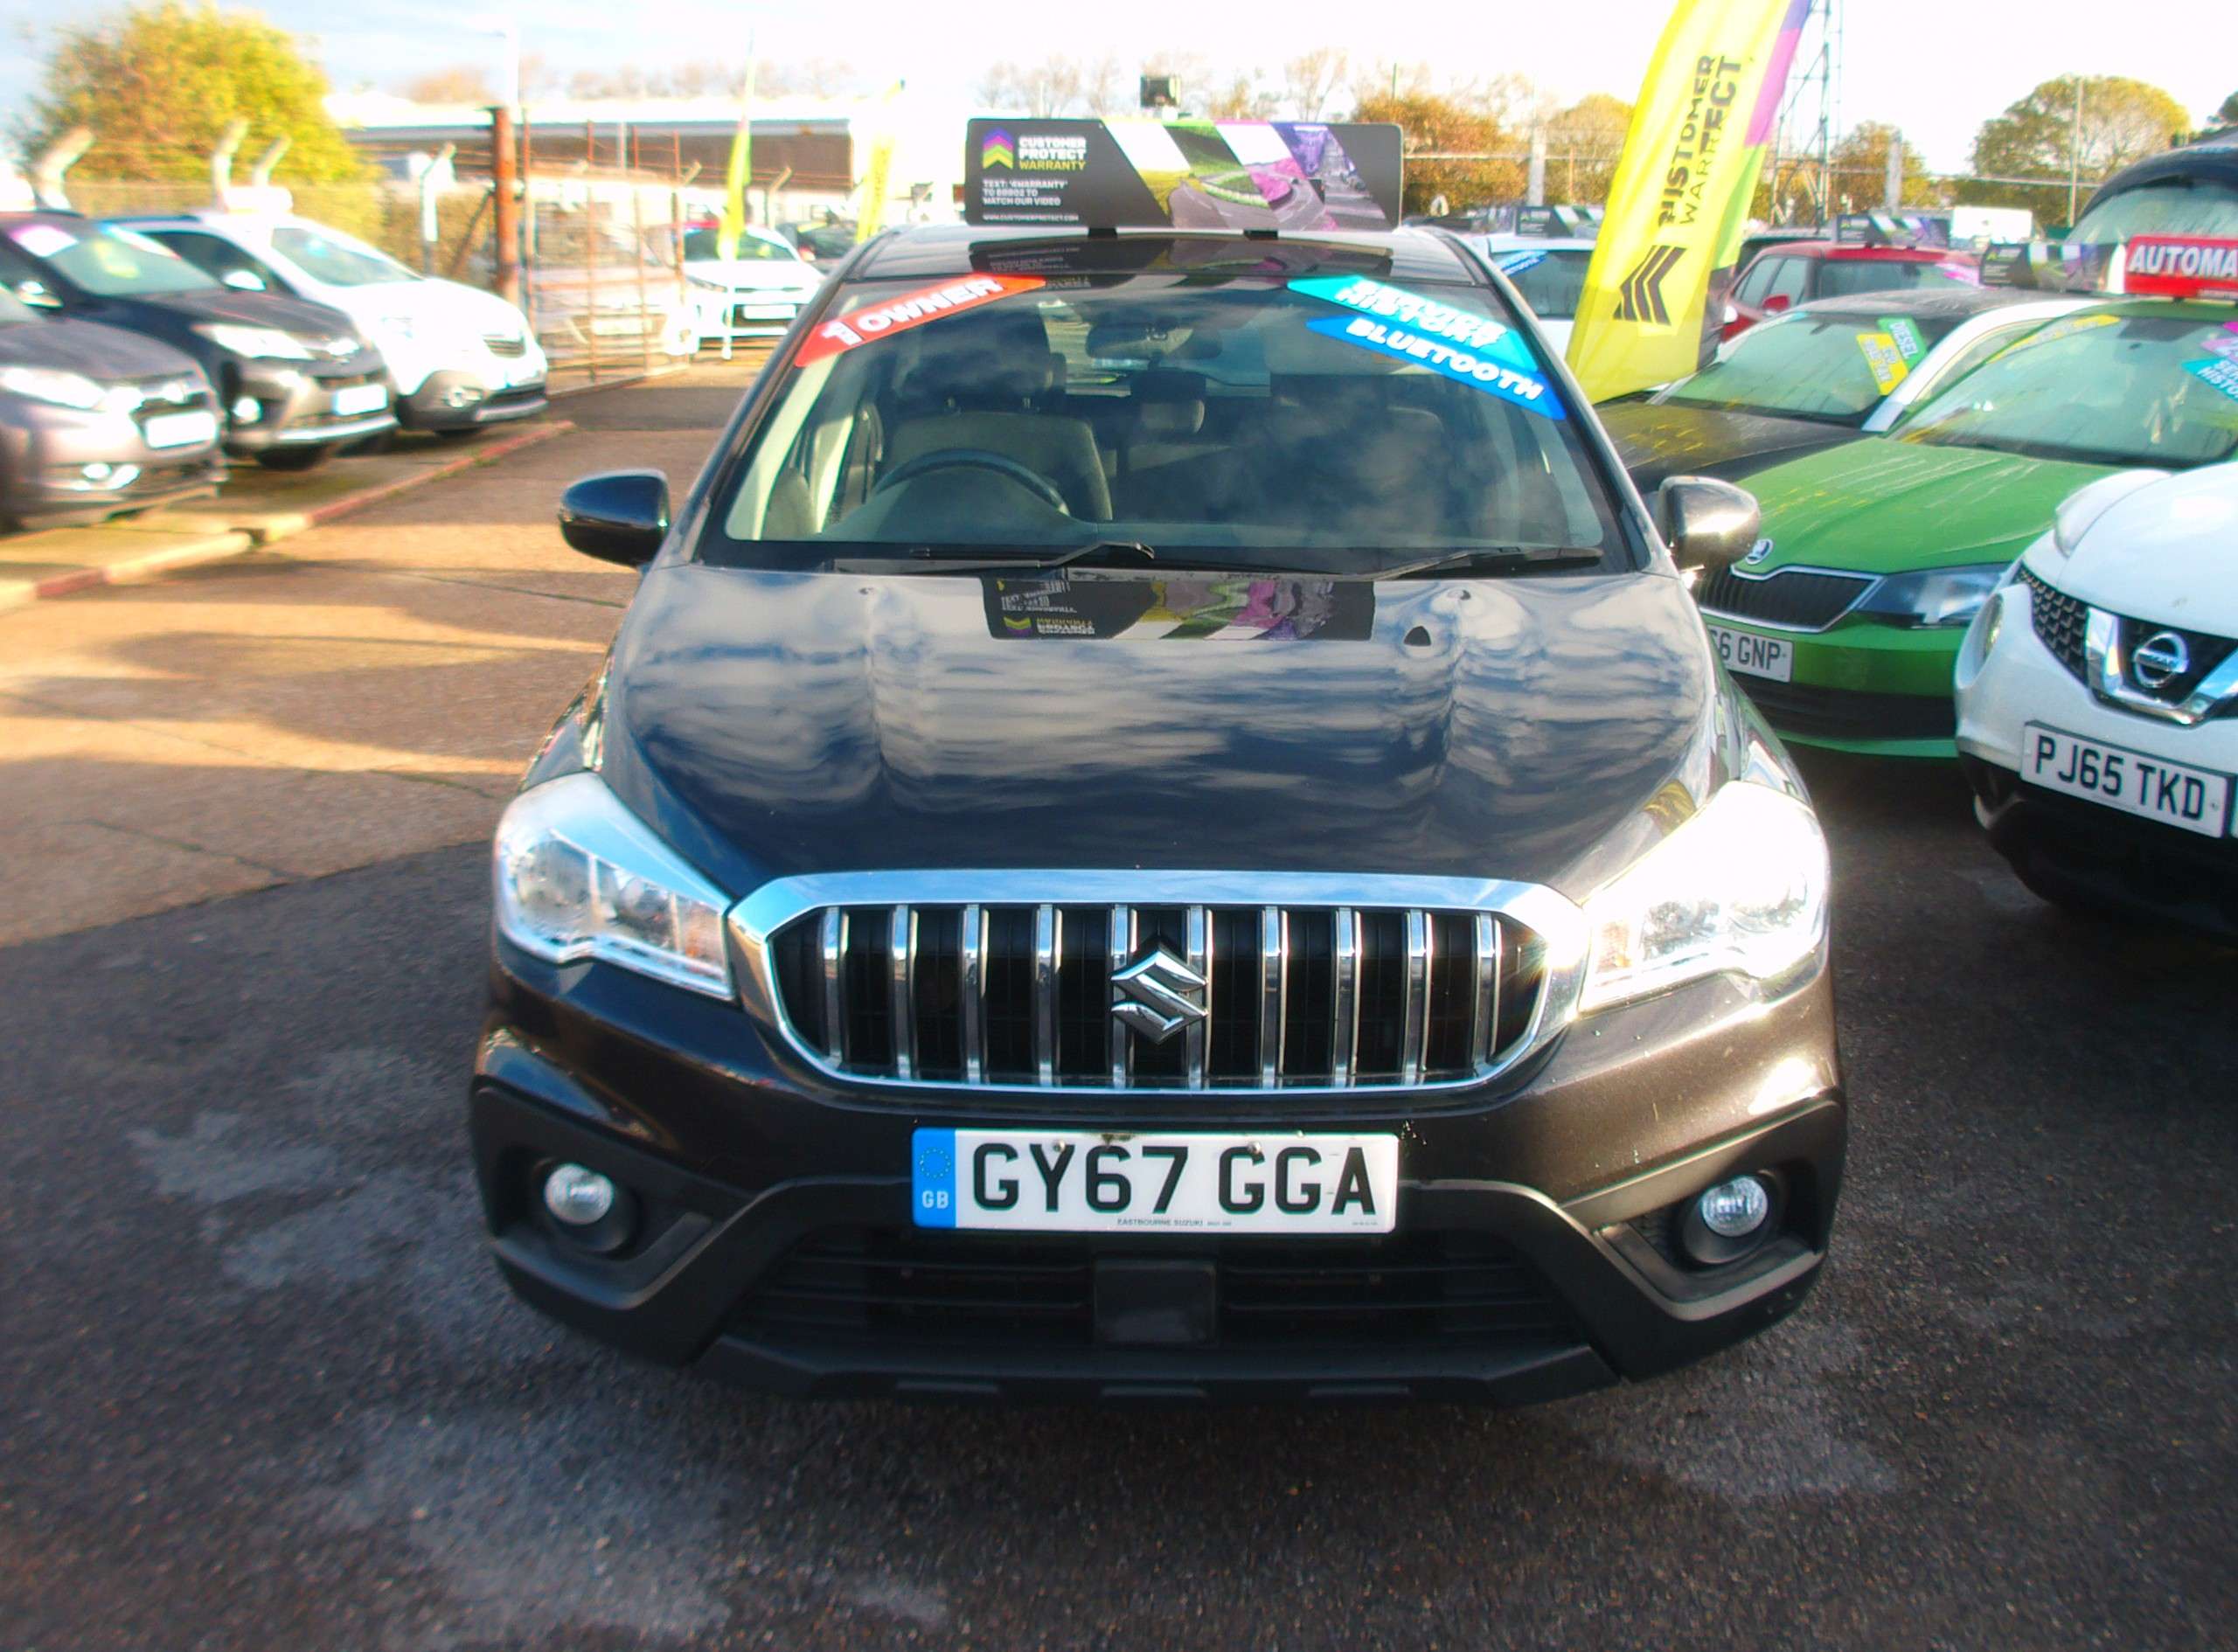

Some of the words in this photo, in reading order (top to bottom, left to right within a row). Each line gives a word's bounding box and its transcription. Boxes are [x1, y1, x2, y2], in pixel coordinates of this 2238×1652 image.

[1018, 148, 1087, 160] PROTECT
[1019, 160, 1087, 170] WARRANTY
[1033, 197, 1061, 206] VIDEO
[822, 320, 864, 347] 1
[857, 278, 1005, 332] OWNER
[1345, 317, 1545, 400] BLUETOOTH
[1738, 635, 1781, 670] GNP
[2035, 734, 2124, 797] PJ65
[2136, 761, 2206, 822] TKD
[973, 1142, 1189, 1214] GY67
[1219, 1146, 1376, 1215] GGA
[921, 1190, 949, 1209] GB
[1173, 1218, 1204, 1227] SUZUKI
